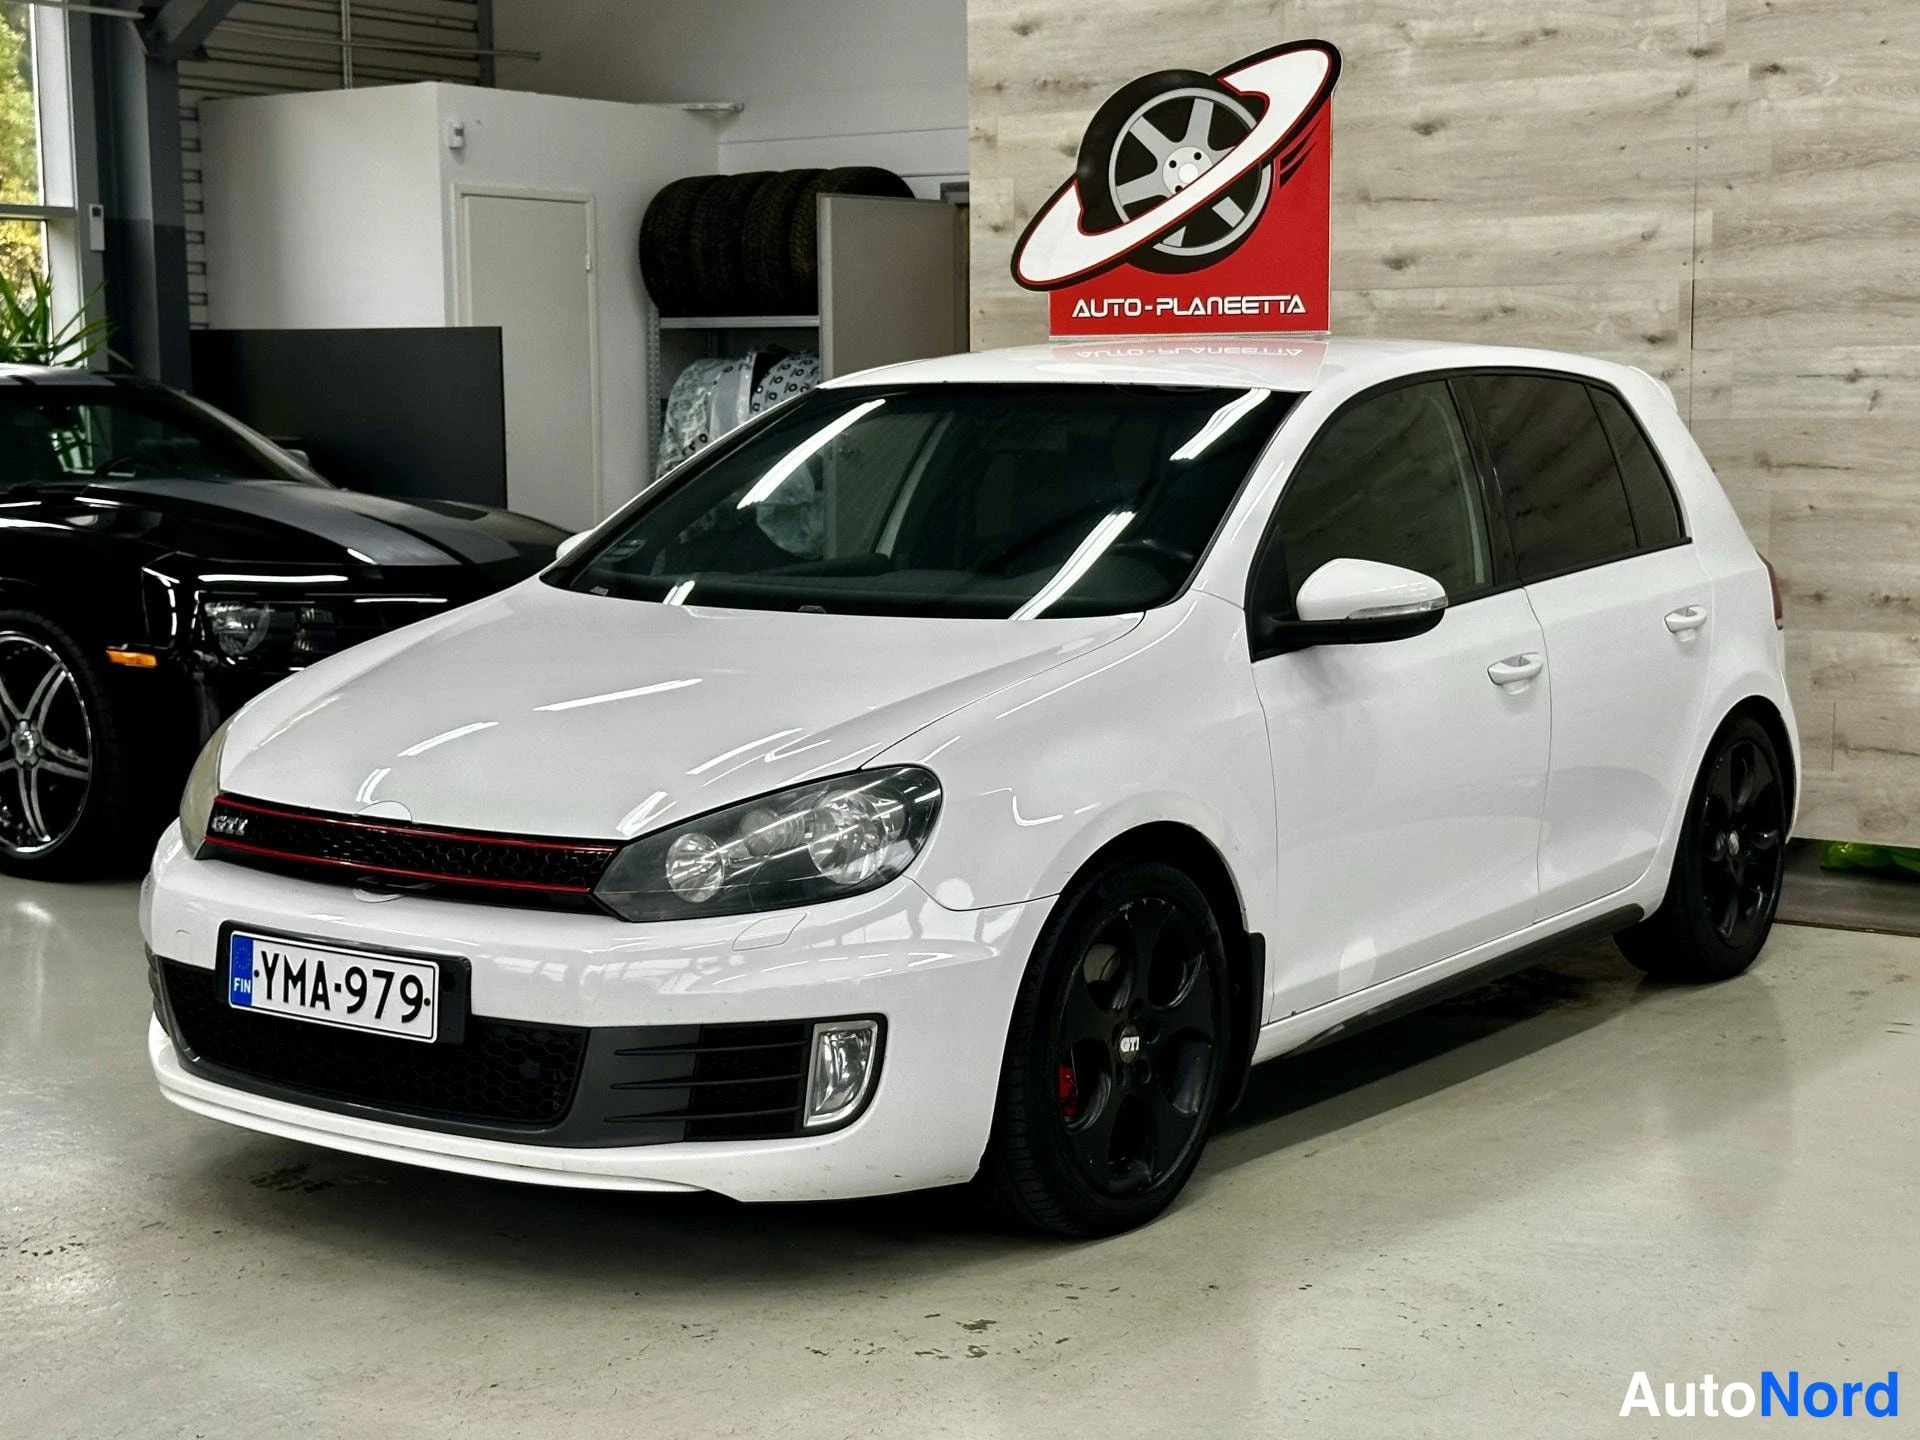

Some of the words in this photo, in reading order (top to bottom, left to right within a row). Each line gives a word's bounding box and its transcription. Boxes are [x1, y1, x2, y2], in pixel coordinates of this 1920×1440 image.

[1071, 295, 1306, 318] AUTO-PLANEETTA
[211, 815, 249, 836] GTI
[233, 978, 251, 993] FIN
[261, 951, 424, 1023] YMA-979
[1120, 1036, 1140, 1052] GTI
